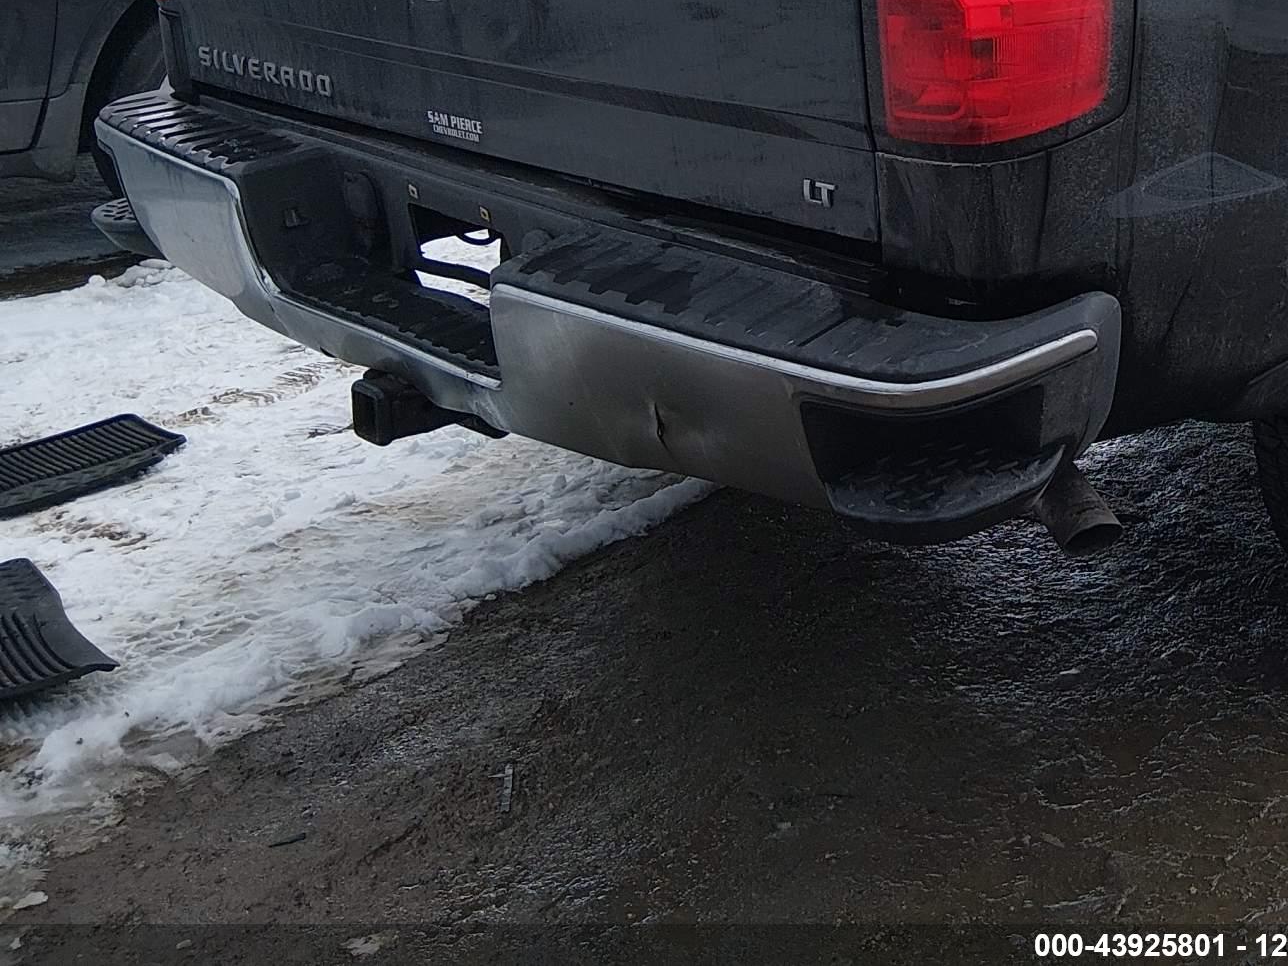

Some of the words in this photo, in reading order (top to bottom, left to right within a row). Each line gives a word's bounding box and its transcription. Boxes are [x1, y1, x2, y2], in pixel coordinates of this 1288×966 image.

[198, 45, 332, 97] SILVERADO
[427, 110, 449, 126] SAM
[450, 115, 483, 134] PIERCE
[803, 179, 835, 208] LT
